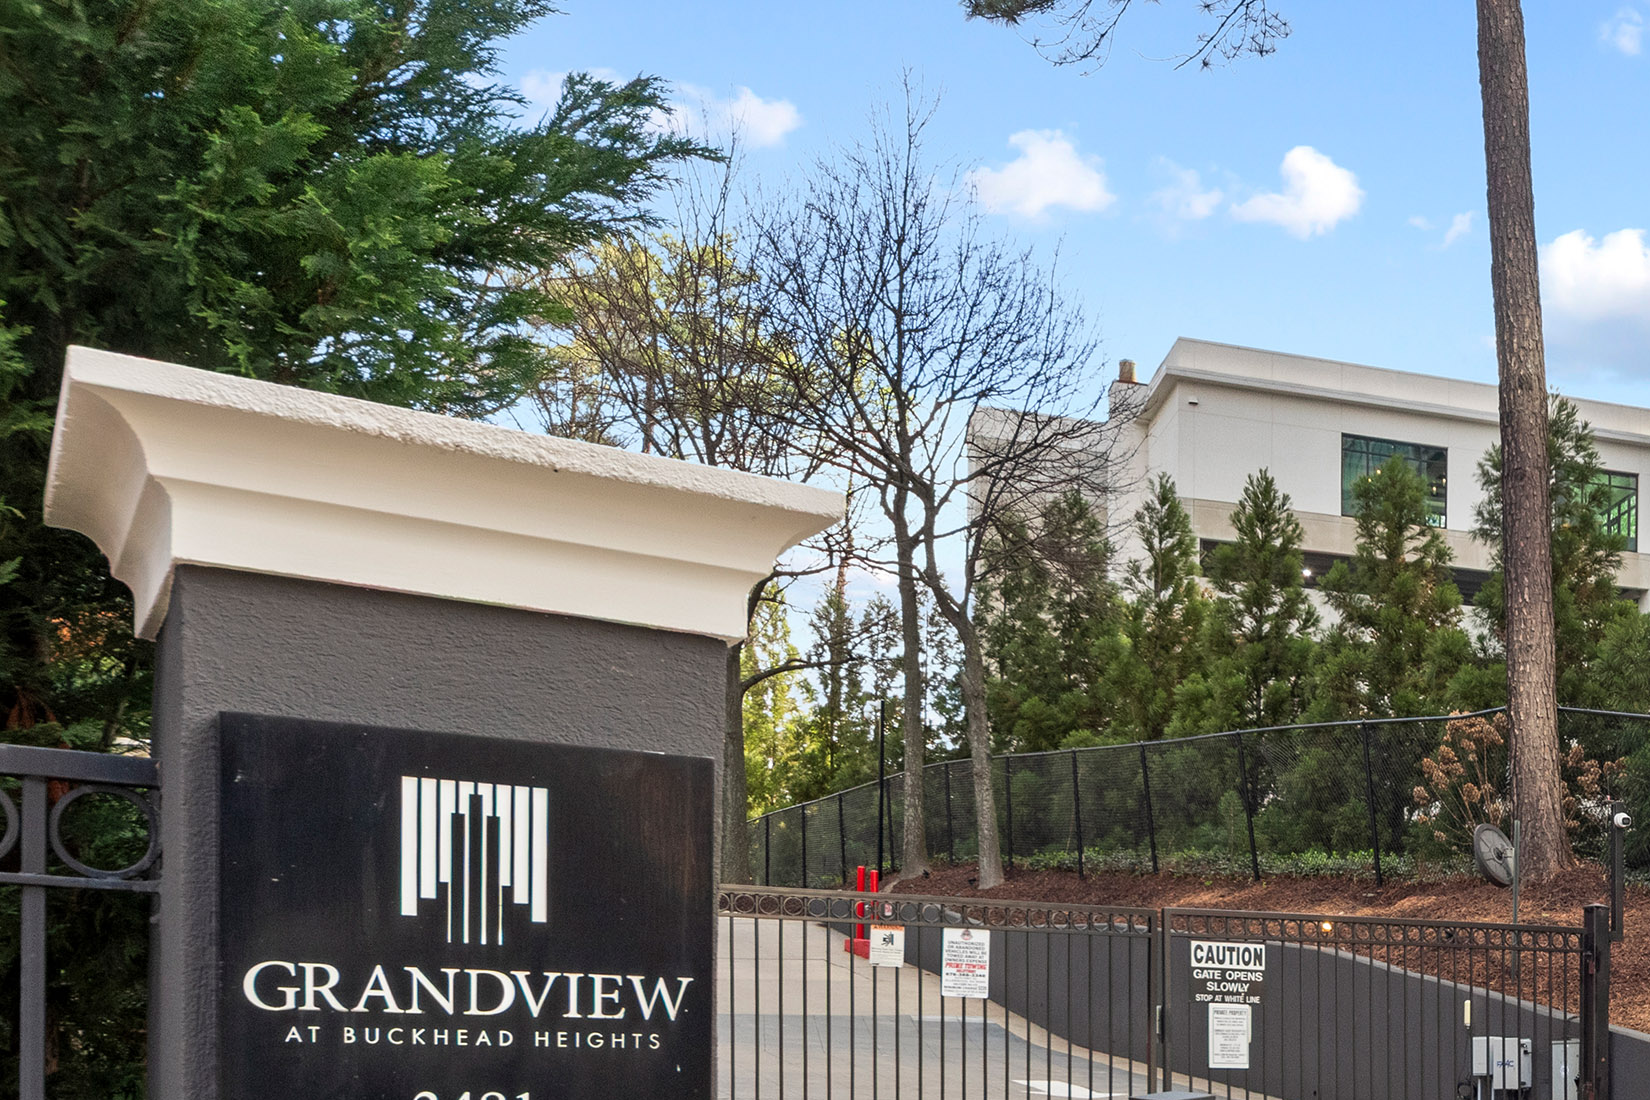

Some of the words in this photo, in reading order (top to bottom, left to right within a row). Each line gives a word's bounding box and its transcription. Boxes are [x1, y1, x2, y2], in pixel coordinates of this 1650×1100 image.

[1193, 944, 1263, 966] CAUTION
[1193, 969, 1222, 979] GATE
[1225, 971, 1263, 982] OPENS
[243, 960, 694, 1022] GRANDVIEW
[1206, 981, 1250, 992] SLOWLY
[1195, 993, 1213, 1002] STOP
[1224, 995, 1245, 1003] WHITE
[1246, 996, 1261, 1004] LINE
[285, 1026, 321, 1043] AT
[344, 1027, 515, 1048] BUCKHEAD
[534, 1031, 662, 1050] HEIGHTS
